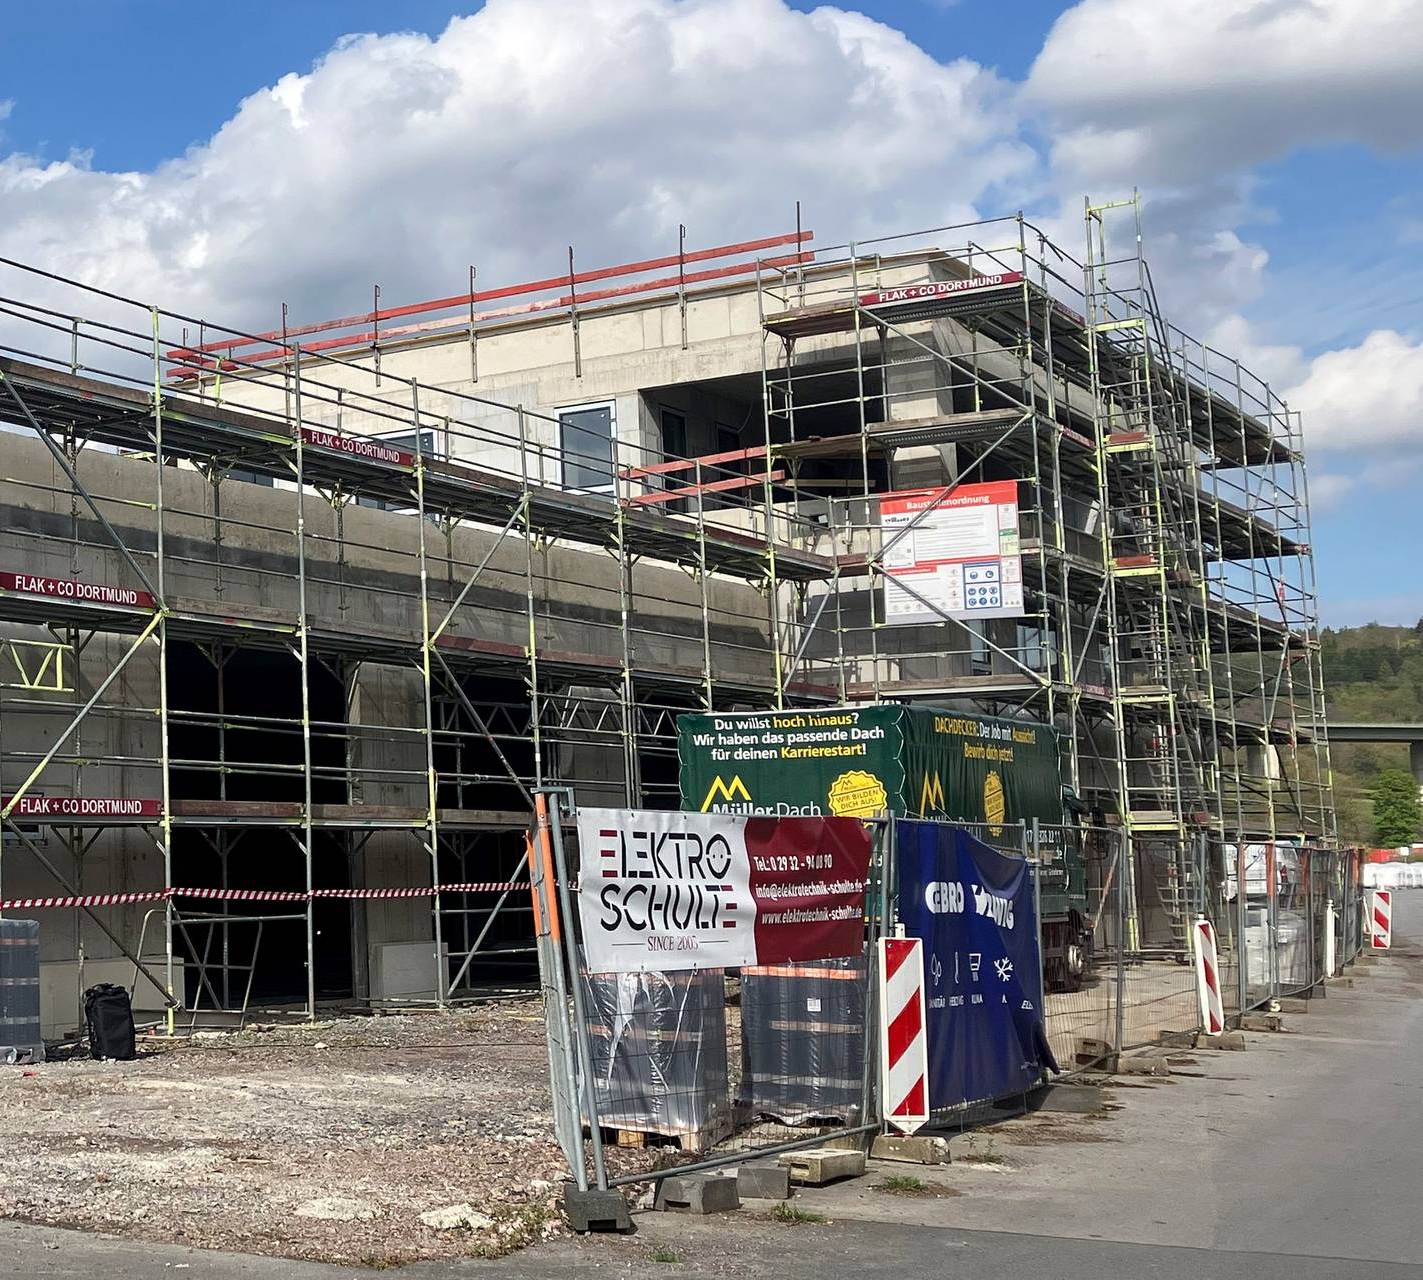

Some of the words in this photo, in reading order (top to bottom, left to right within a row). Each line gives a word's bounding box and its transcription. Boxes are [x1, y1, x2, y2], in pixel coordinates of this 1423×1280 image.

[879, 288, 908, 302] FLAK
[910, 288, 917, 297] +
[919, 285, 936, 296] CO
[938, 275, 1002, 293] DORTMUND
[311, 432, 334, 447] FLAK
[335, 438, 340, 447] +
[341, 439, 354, 452] CO
[355, 442, 400, 463] DORTMUND
[15, 575, 46, 593] FLAK
[48, 582, 55, 592] +
[57, 581, 74, 596] CO
[77, 584, 137, 604] DORTMUND
[715, 719, 733, 730] Du
[736, 718, 771, 730] willst
[773, 716, 805, 729] hoch
[809, 713, 859, 726] hinaus?
[693, 734, 715, 746] Wir
[718, 732, 758, 746] haben
[761, 731, 784, 744] das
[787, 729, 848, 745] passende
[851, 726, 885, 740] Dach
[711, 749, 730, 761] für
[734, 747, 778, 760] deinen
[781, 744, 867, 759] Karrierestart!
[20, 799, 50, 813] FLAK
[53, 803, 60, 812] +
[62, 799, 78, 813] CO
[81, 800, 142, 814] DORTMUND
[600, 830, 732, 880] ELEKTRO
[777, 856, 788, 871] 29
[789, 855, 800, 871] 32
[600, 883, 738, 932] SCHULTE
[648, 935, 675, 951] SINCE
[677, 934, 699, 951] 2005
